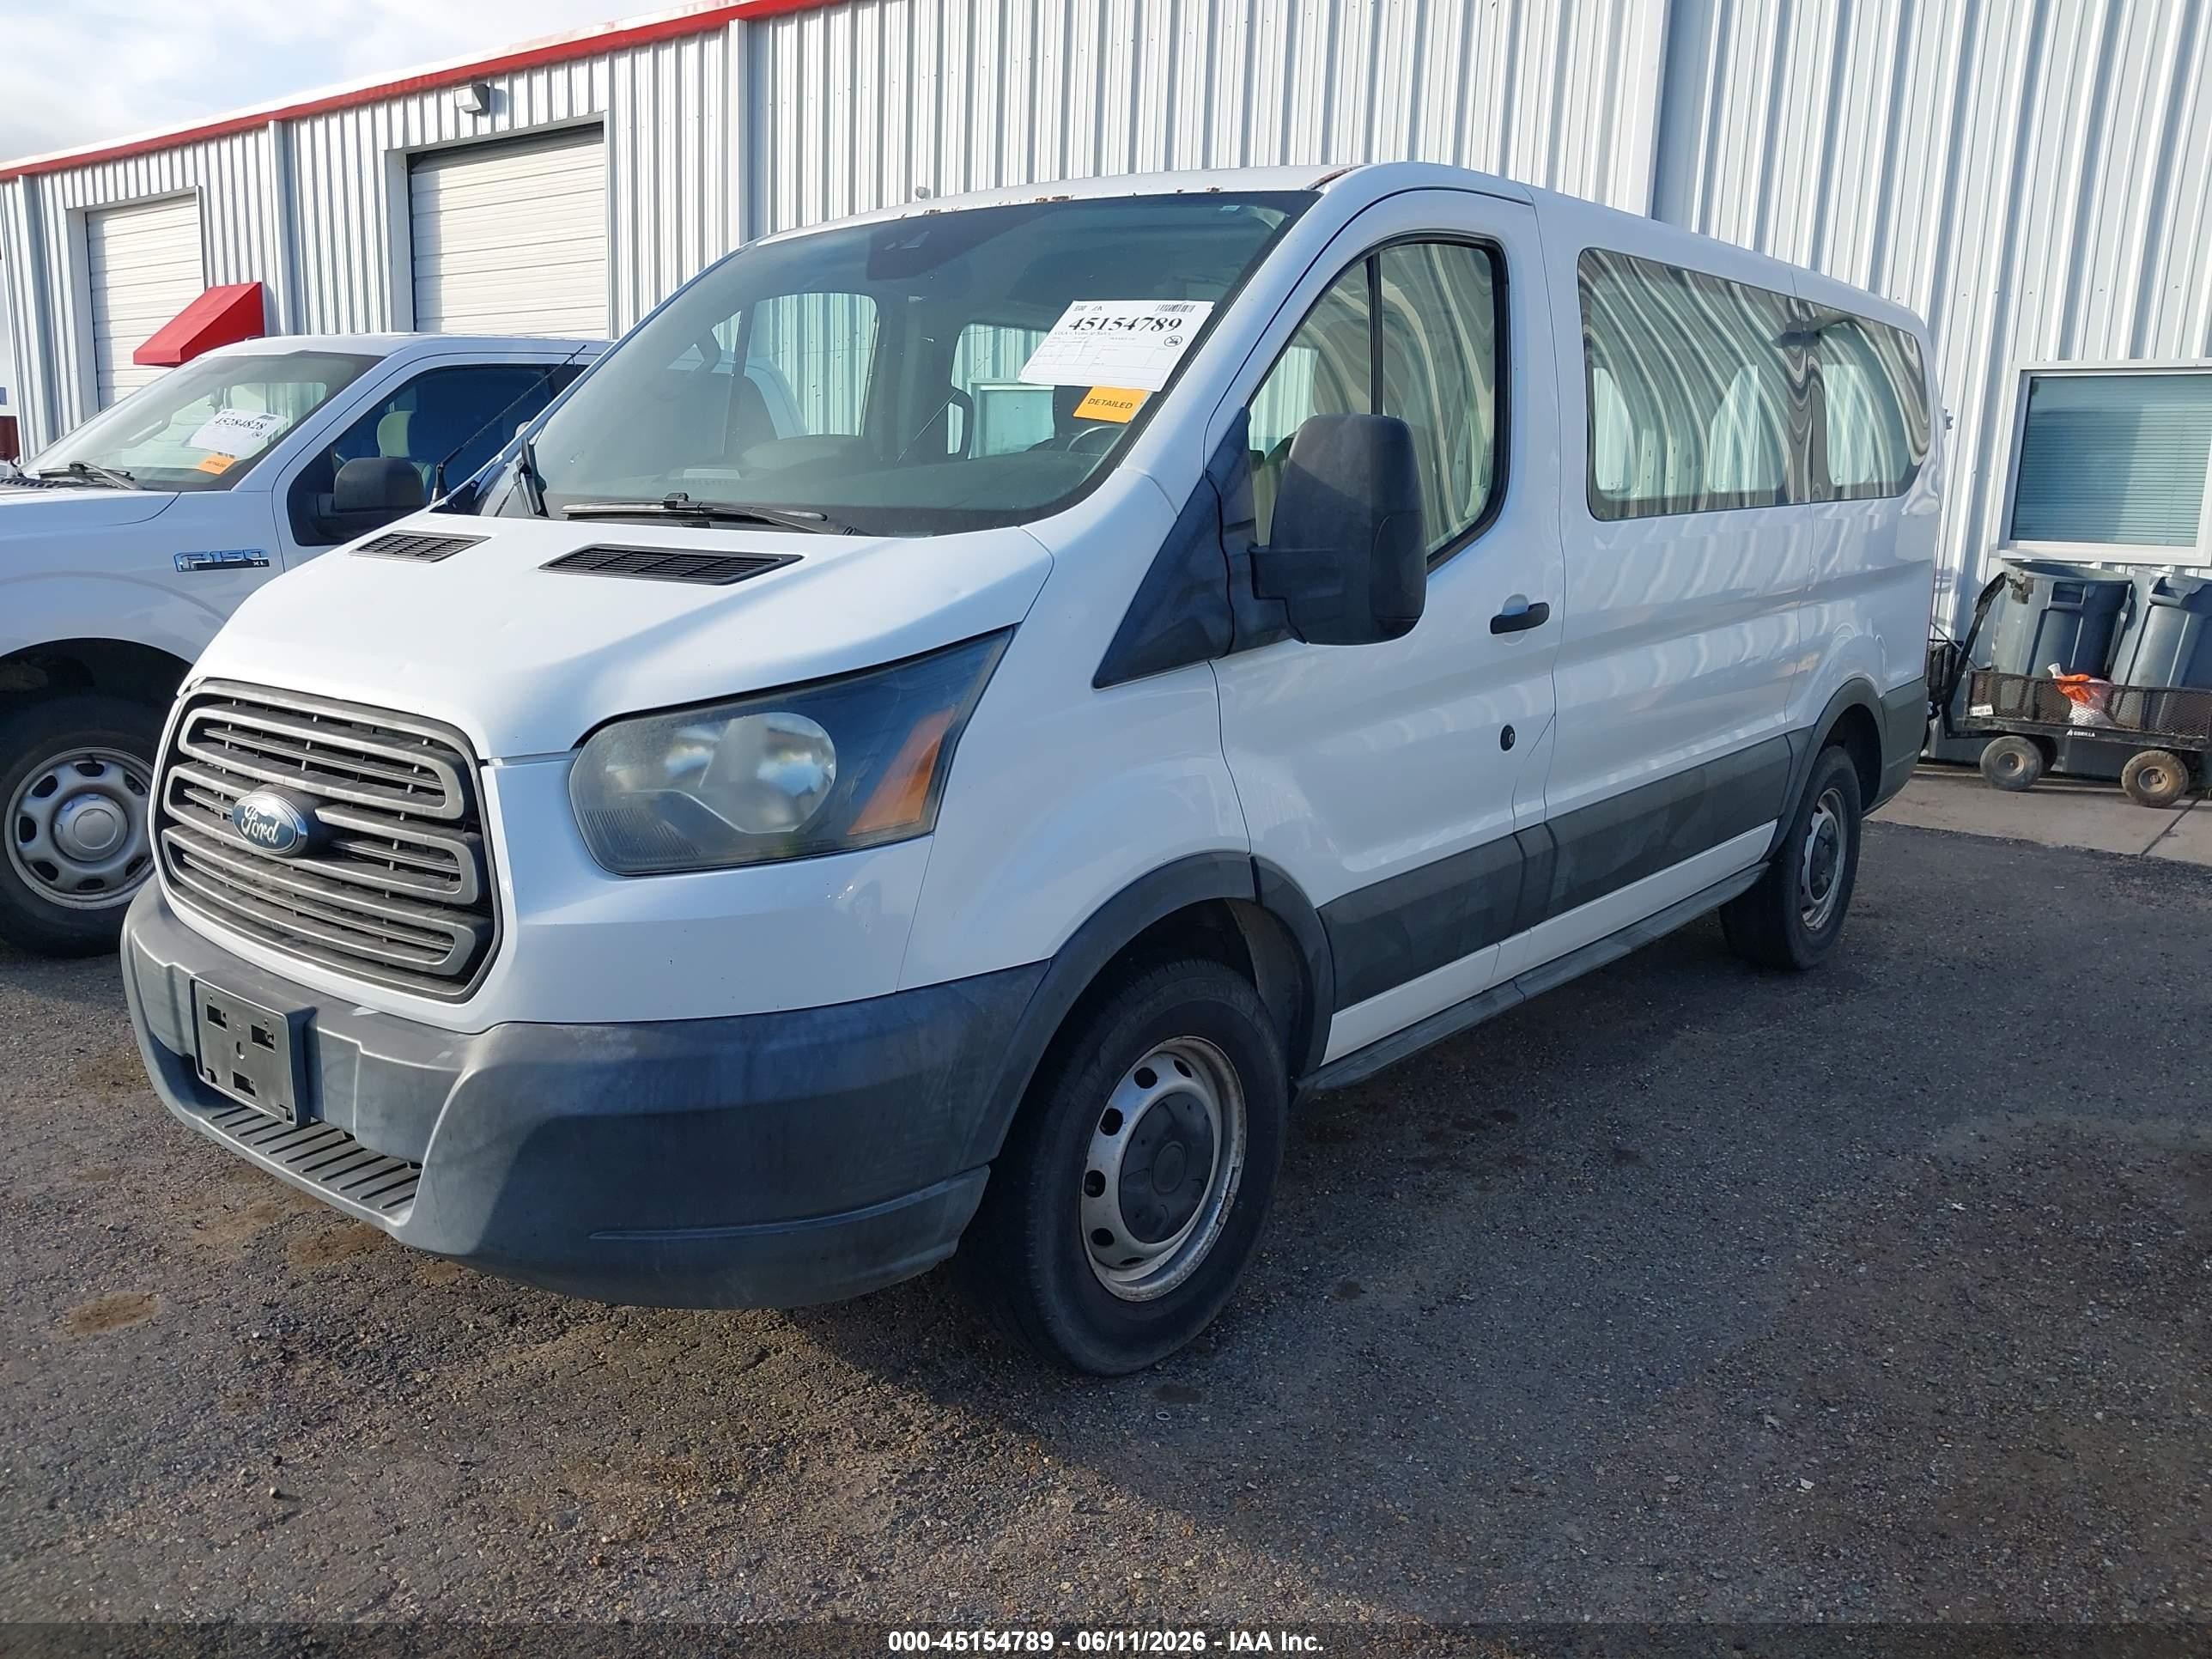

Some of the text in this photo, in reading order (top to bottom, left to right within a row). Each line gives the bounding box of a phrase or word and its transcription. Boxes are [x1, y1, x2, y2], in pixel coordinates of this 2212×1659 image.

[1068, 317, 1182, 332] 45154789
[1087, 398, 1133, 410] DETAILED
[240, 805, 279, 845] Ford
